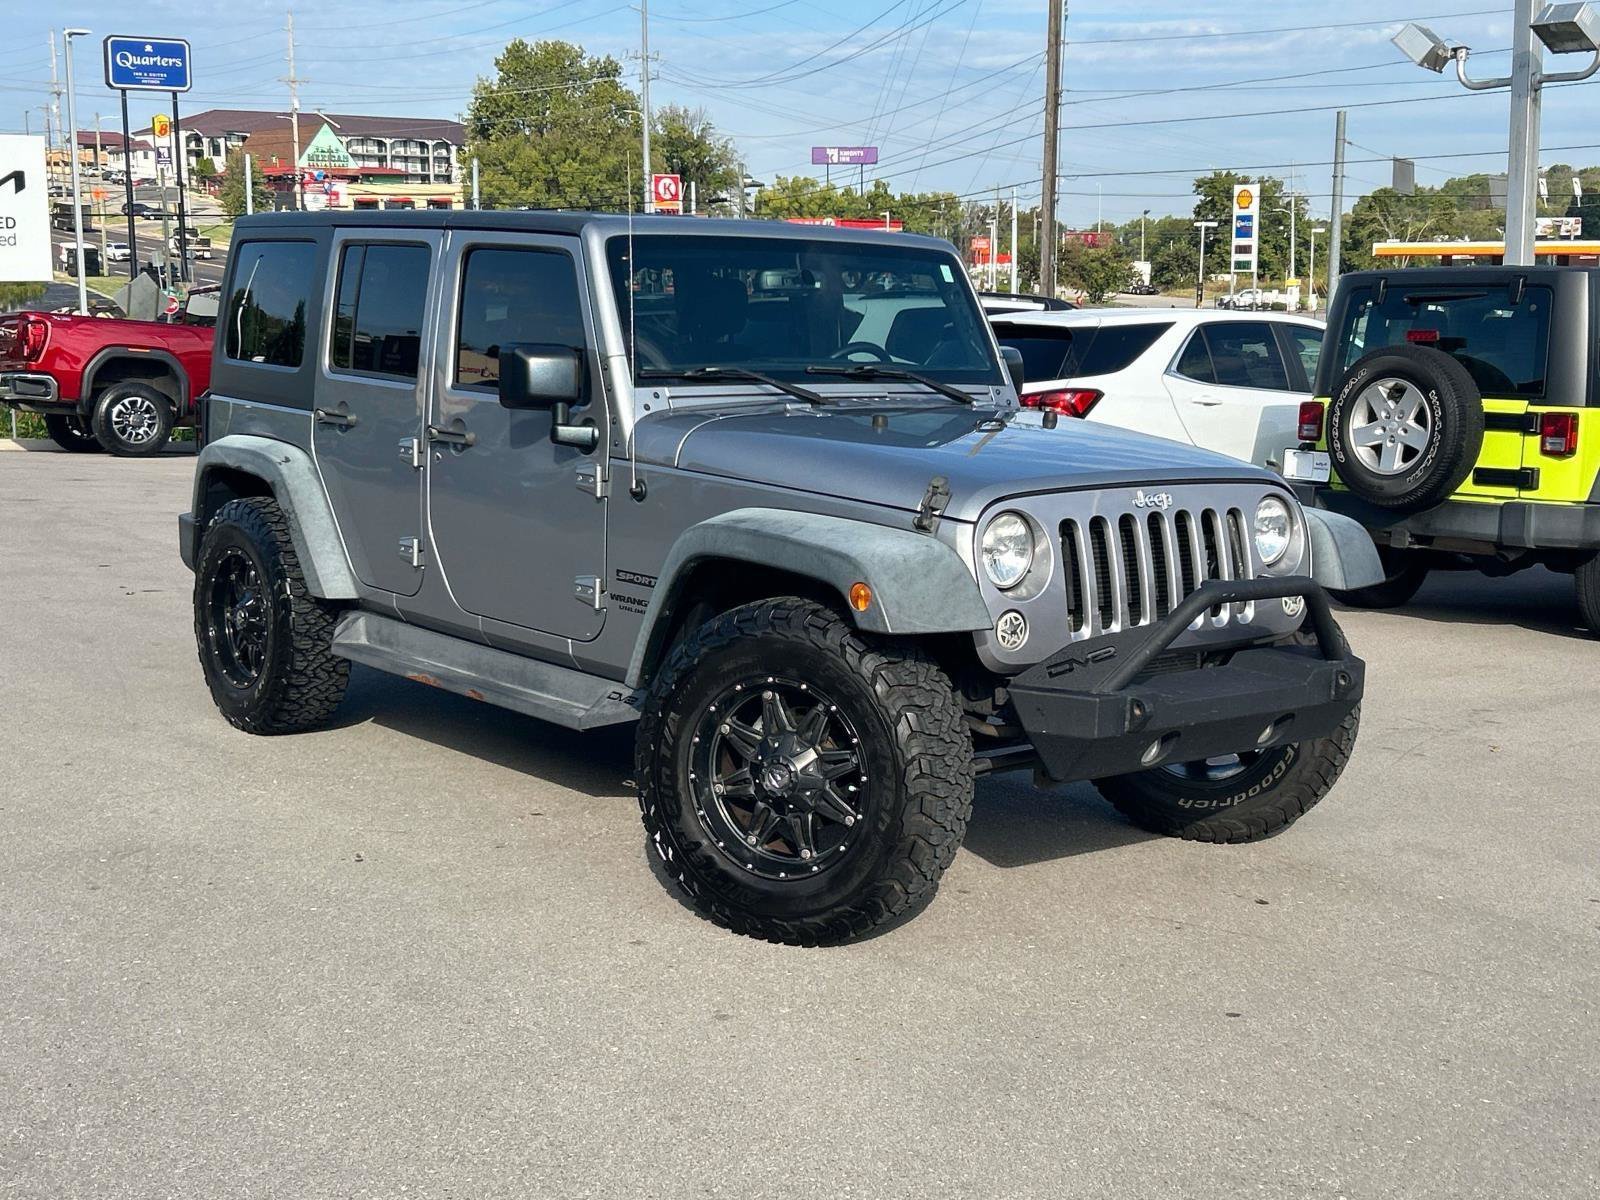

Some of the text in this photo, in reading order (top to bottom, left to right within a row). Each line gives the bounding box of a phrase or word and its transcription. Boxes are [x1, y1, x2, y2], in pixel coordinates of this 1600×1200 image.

[116, 51, 182, 69] Quarters
[663, 182, 675, 197] K
[1132, 490, 1173, 510] Jeep
[618, 571, 656, 586] SPORT
[610, 593, 649, 607] WRANG
